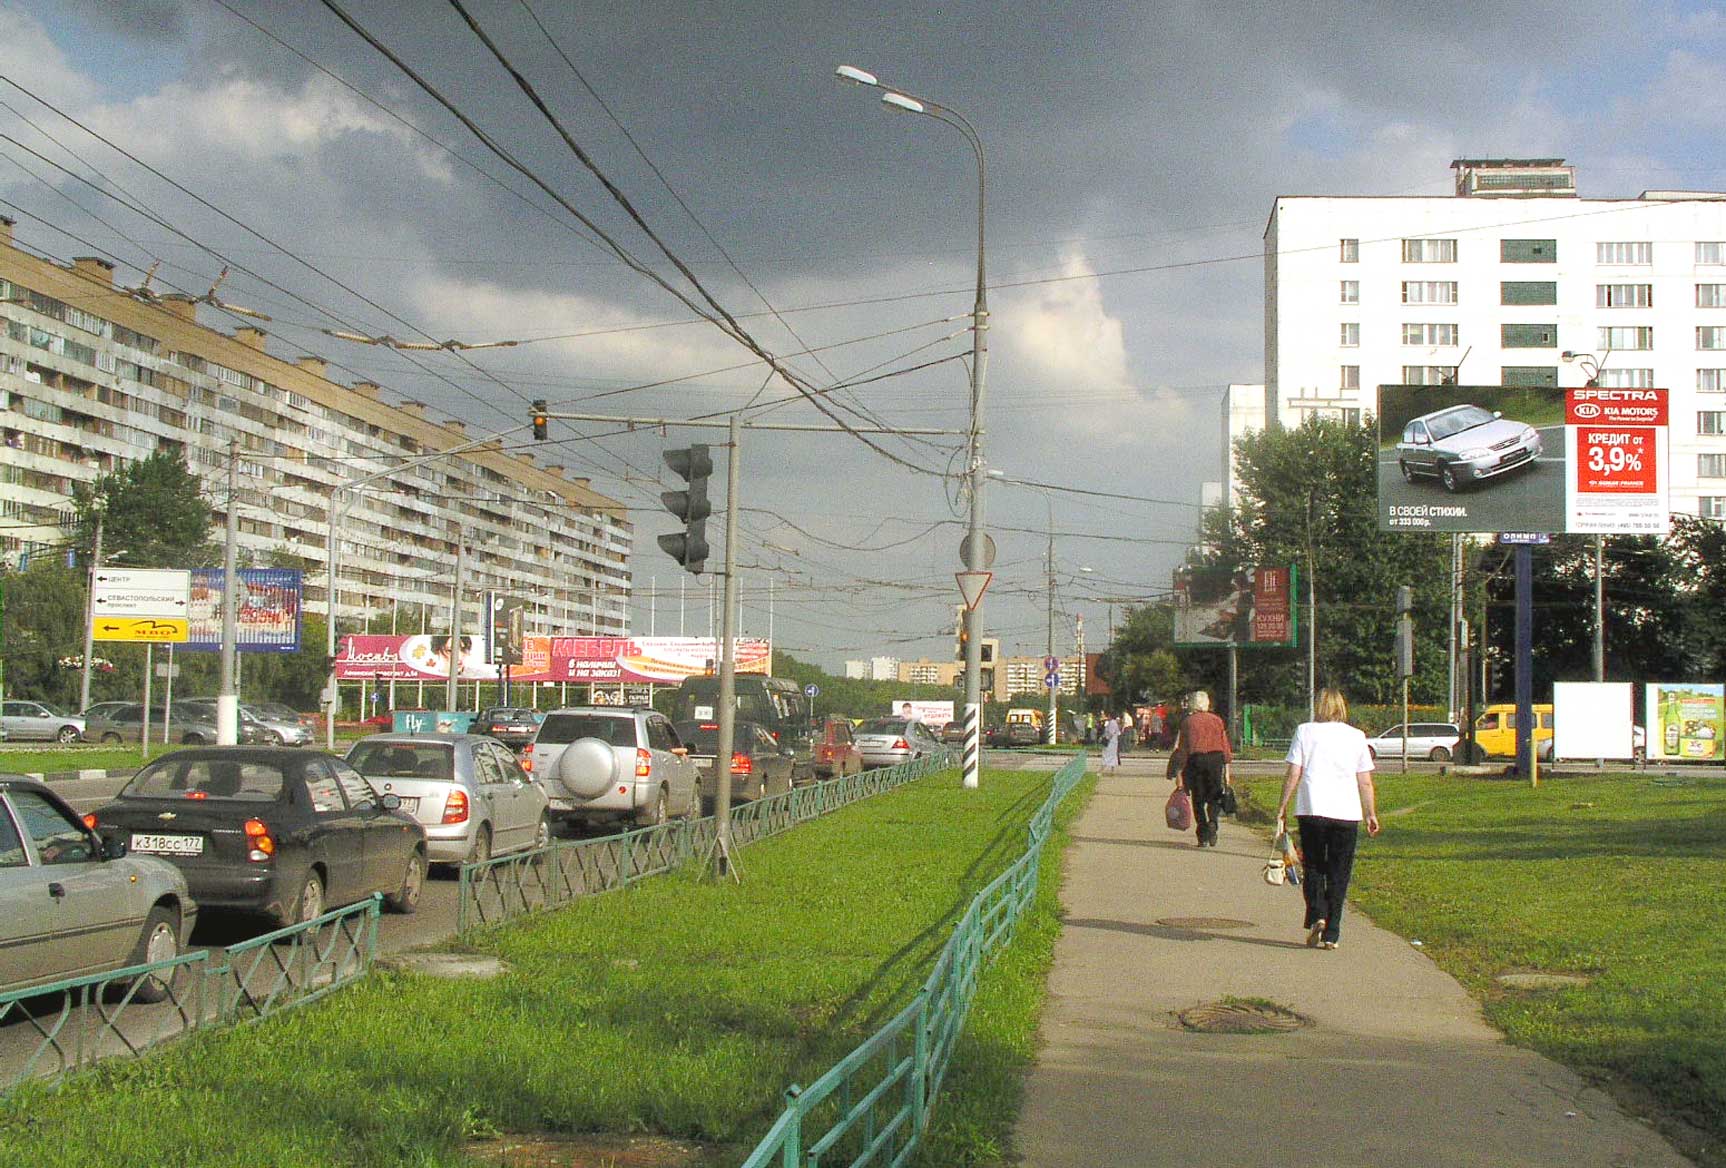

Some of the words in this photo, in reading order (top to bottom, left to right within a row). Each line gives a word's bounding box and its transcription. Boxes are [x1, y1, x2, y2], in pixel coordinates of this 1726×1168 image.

[1573, 390, 1657, 400] SPECTRA
[1578, 406, 1597, 415] KIA
[1604, 407, 1619, 415] KIA
[1621, 407, 1658, 416] MOTORS
[1588, 433, 1631, 446] КРЕДИТ
[1633, 436, 1644, 445] от
[1389, 506, 1396, 517] В
[1397, 504, 1428, 517] СВОЕЙ
[1429, 506, 1468, 517] СТИХИИ.
[107, 594, 175, 602] СЕВАСТОПОЛЬСКИЙ
[552, 639, 642, 657] МЕБЕЛЬ
[576, 660, 617, 669] наличии
[568, 669, 575, 677] и
[576, 669, 590, 677] на
[591, 669, 622, 678] заказ!
